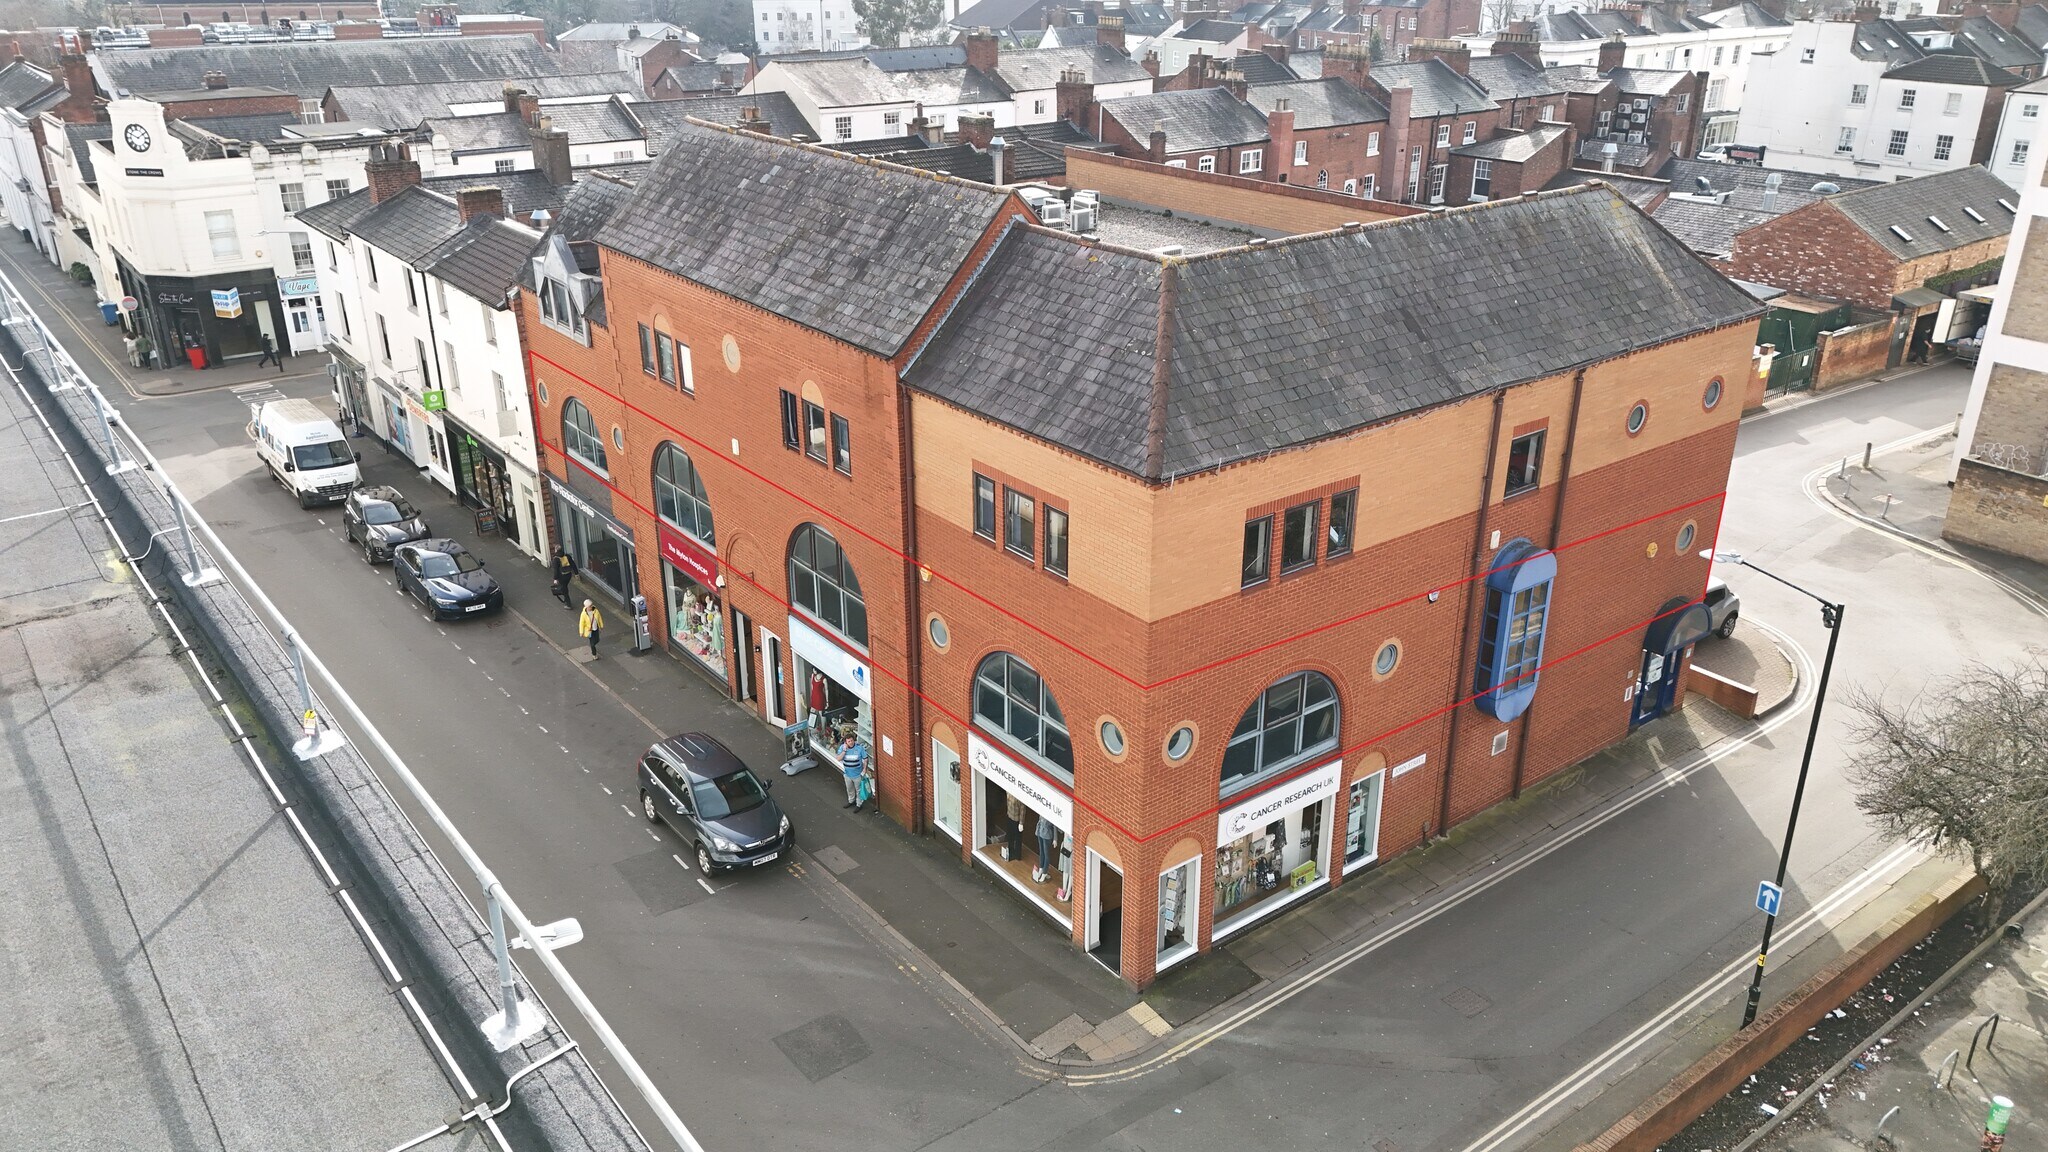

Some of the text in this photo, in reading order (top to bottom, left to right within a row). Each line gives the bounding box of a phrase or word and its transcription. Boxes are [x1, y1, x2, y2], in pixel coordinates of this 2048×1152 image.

[289, 282, 310, 292] Vape
[578, 500, 595, 519] Centre
[667, 542, 676, 554] The
[688, 558, 709, 576] Hospices
[1395, 756, 1425, 775] JOHN STREET
[990, 761, 1063, 818] CANCER RESEARCH UK
[1250, 776, 1334, 821] CANCER RESEARCH UK
